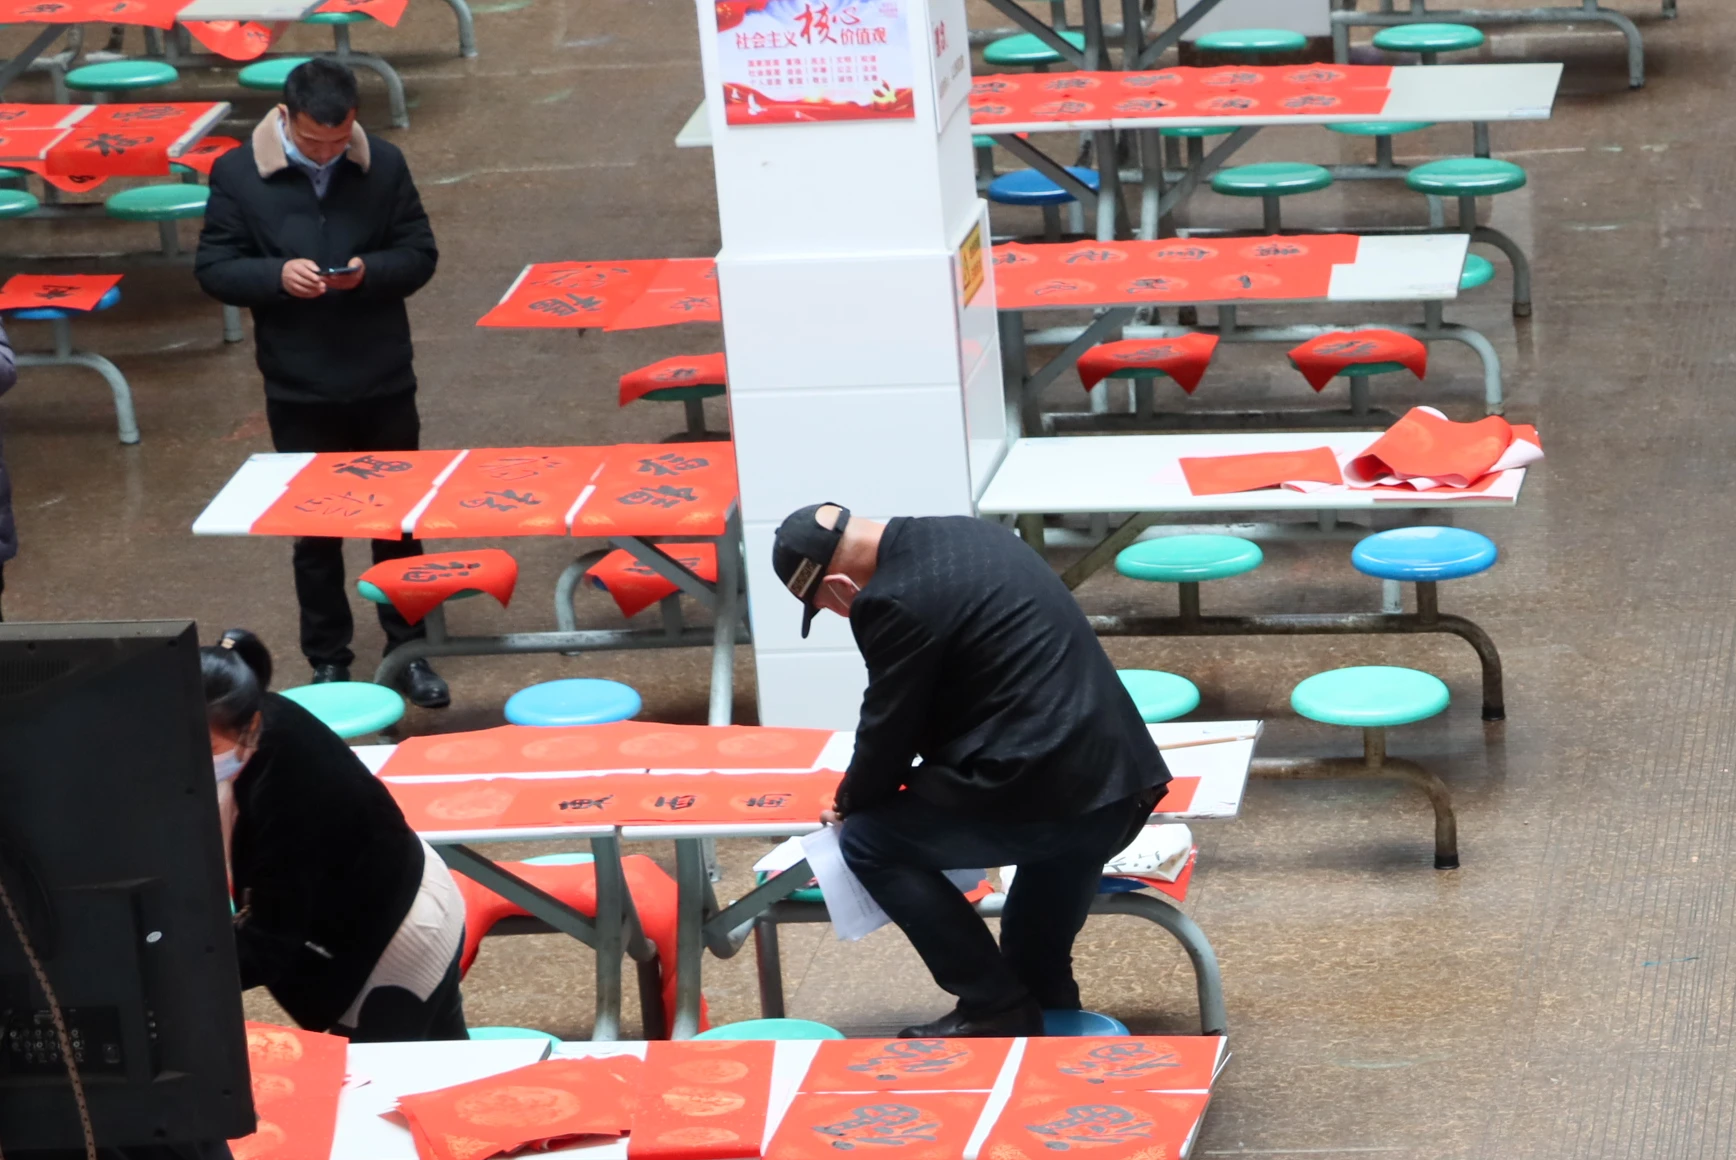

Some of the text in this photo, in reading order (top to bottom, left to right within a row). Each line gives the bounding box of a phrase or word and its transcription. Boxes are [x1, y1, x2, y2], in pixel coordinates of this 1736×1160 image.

[794, 2, 861, 45] 核心
[735, 32, 798, 50] 社会主义
[840, 27, 888, 46] 价值观
[332, 454, 414, 479] 福
[637, 453, 710, 477] 福
